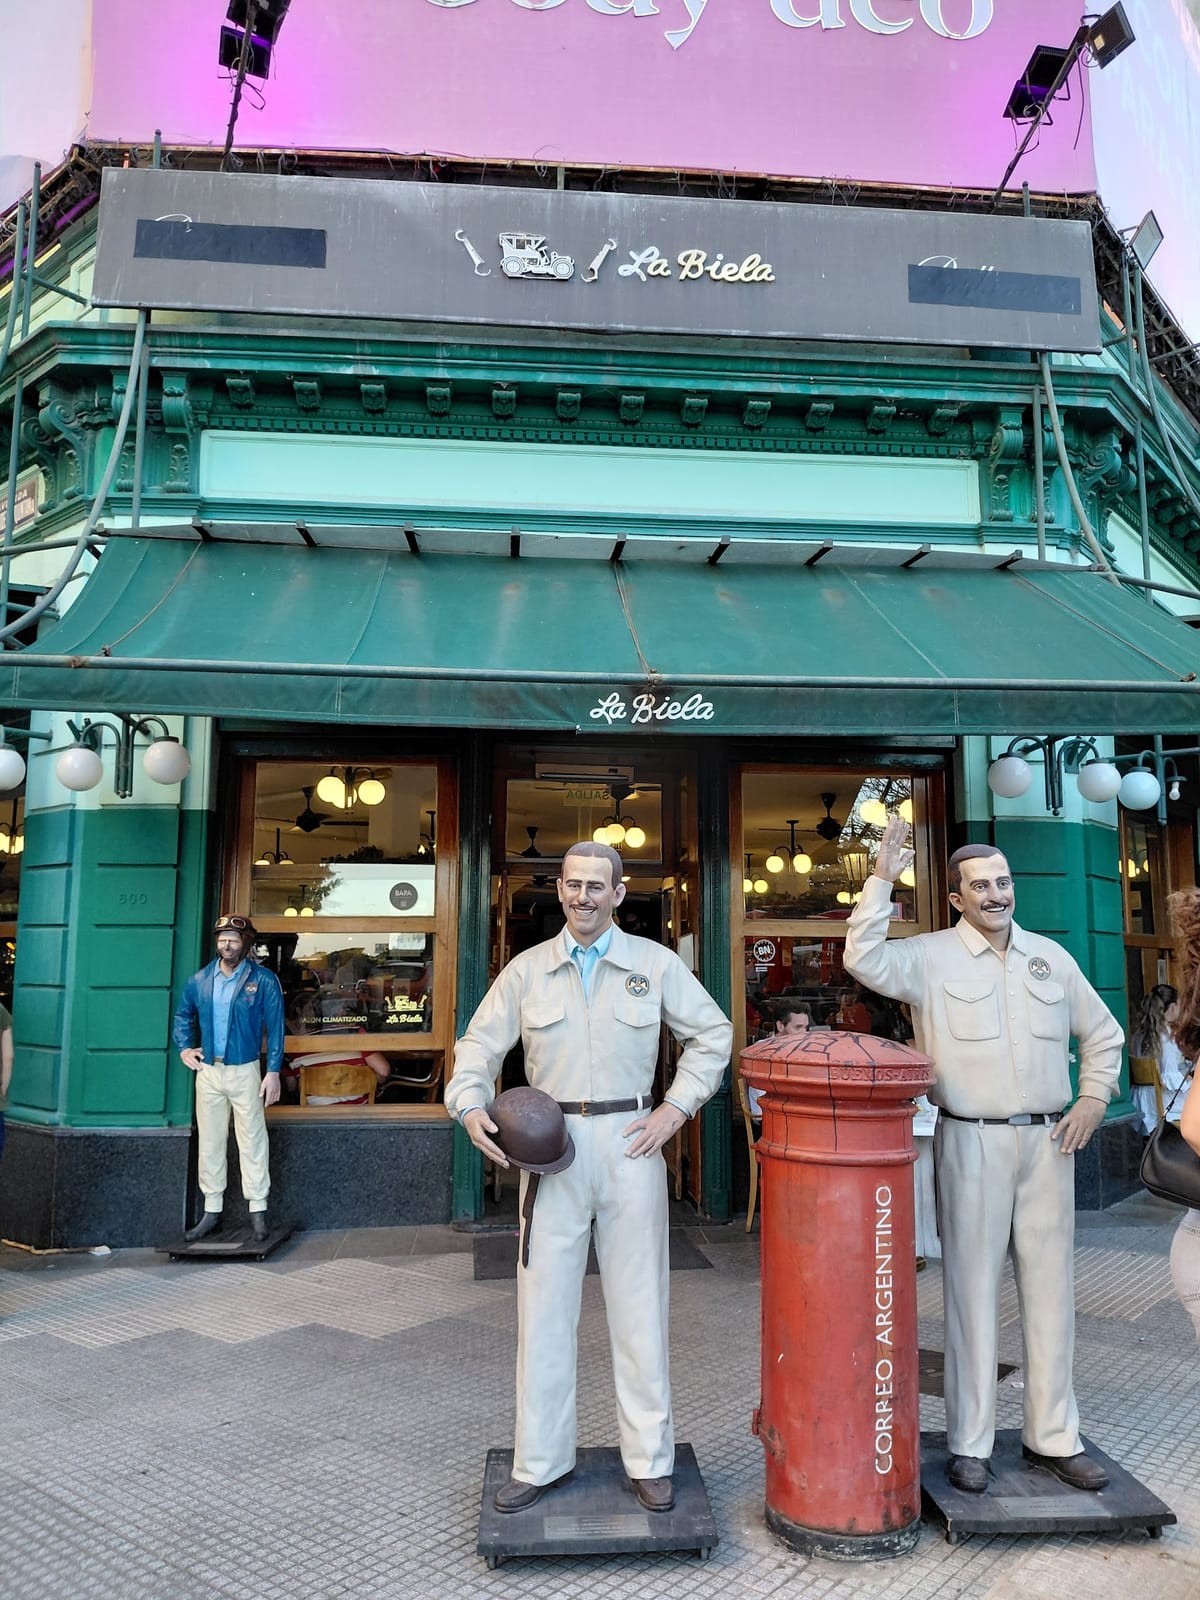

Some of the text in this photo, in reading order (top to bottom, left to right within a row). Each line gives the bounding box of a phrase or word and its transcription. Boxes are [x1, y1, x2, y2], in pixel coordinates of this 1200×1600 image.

[617, 246, 776, 283] La Biela
[589, 692, 715, 725] La Biela
[322, 1015, 368, 1024] CLIMATIZADO
[874, 1184, 894, 1476] CORREO ARGENTINO
